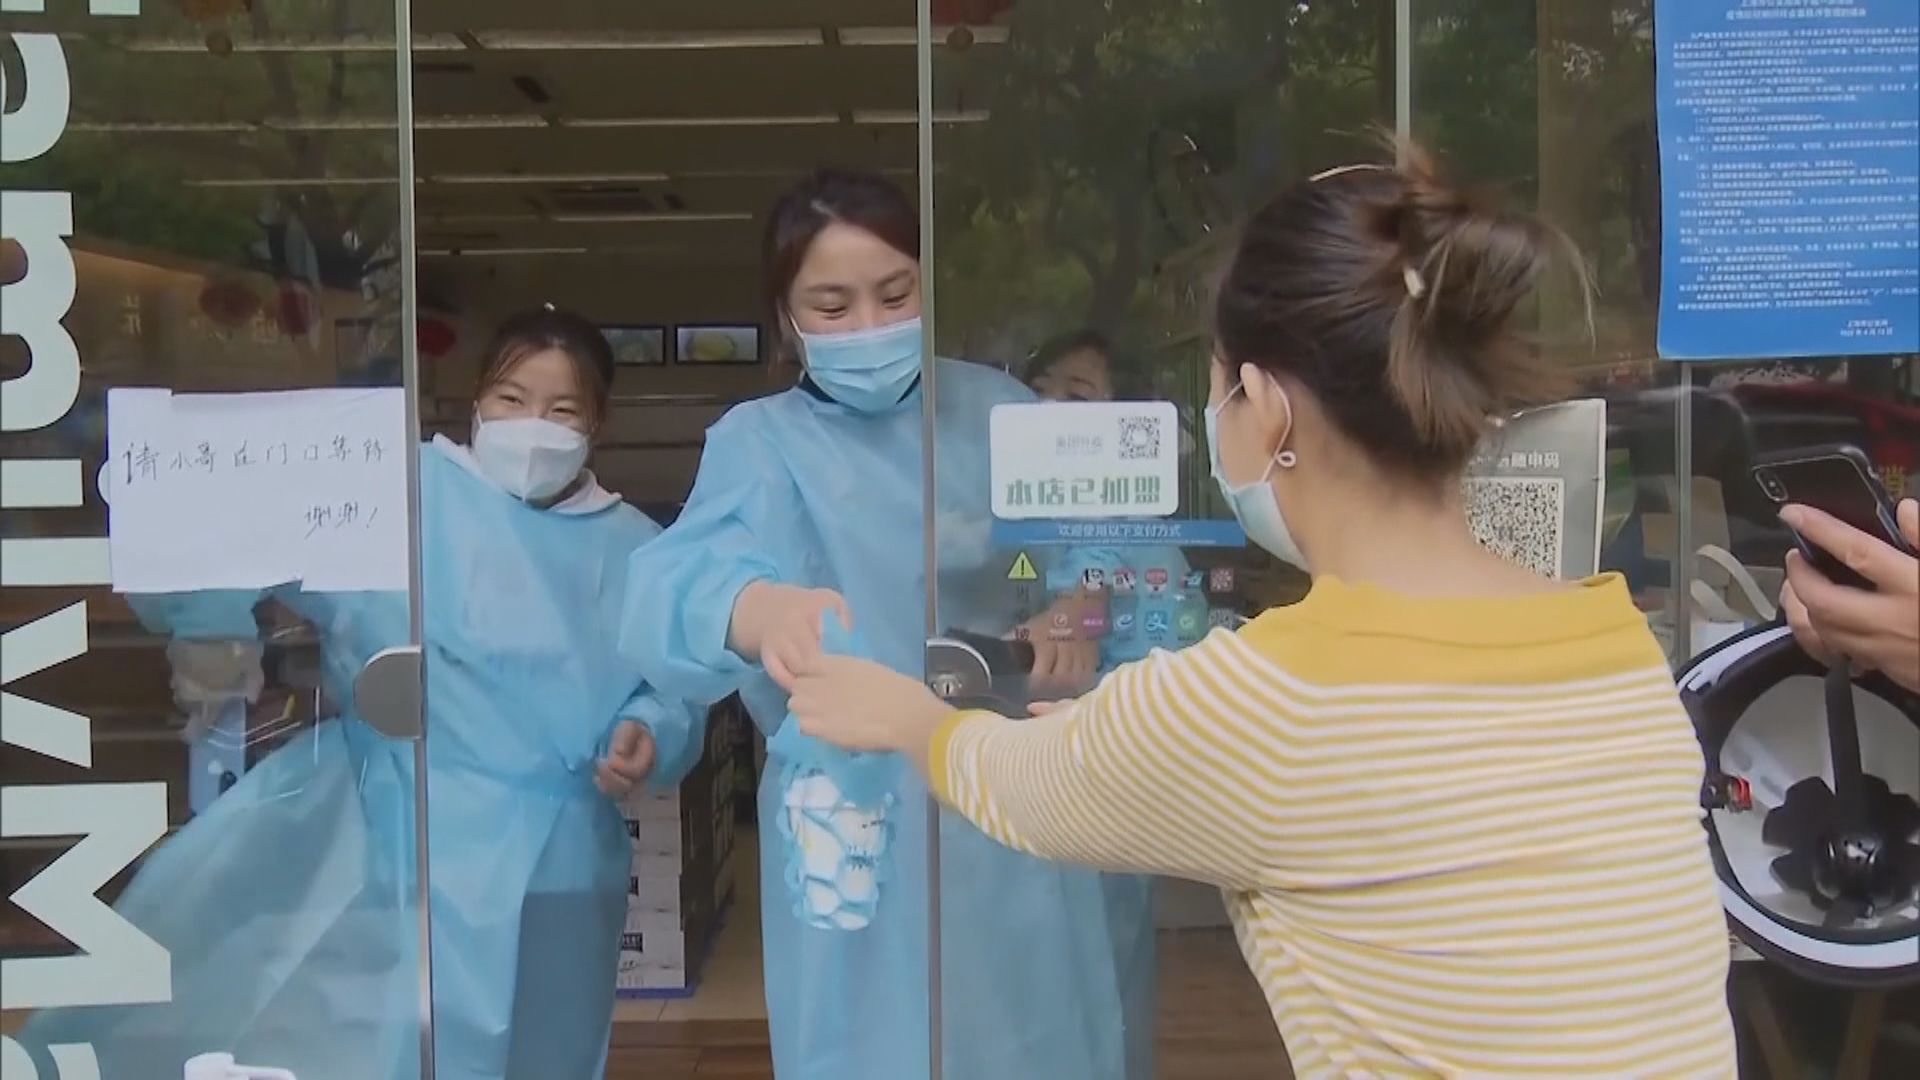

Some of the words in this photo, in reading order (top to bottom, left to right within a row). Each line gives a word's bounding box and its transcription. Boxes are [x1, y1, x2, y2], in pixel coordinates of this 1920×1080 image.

[1005, 475, 1161, 507] 本店已加盟
